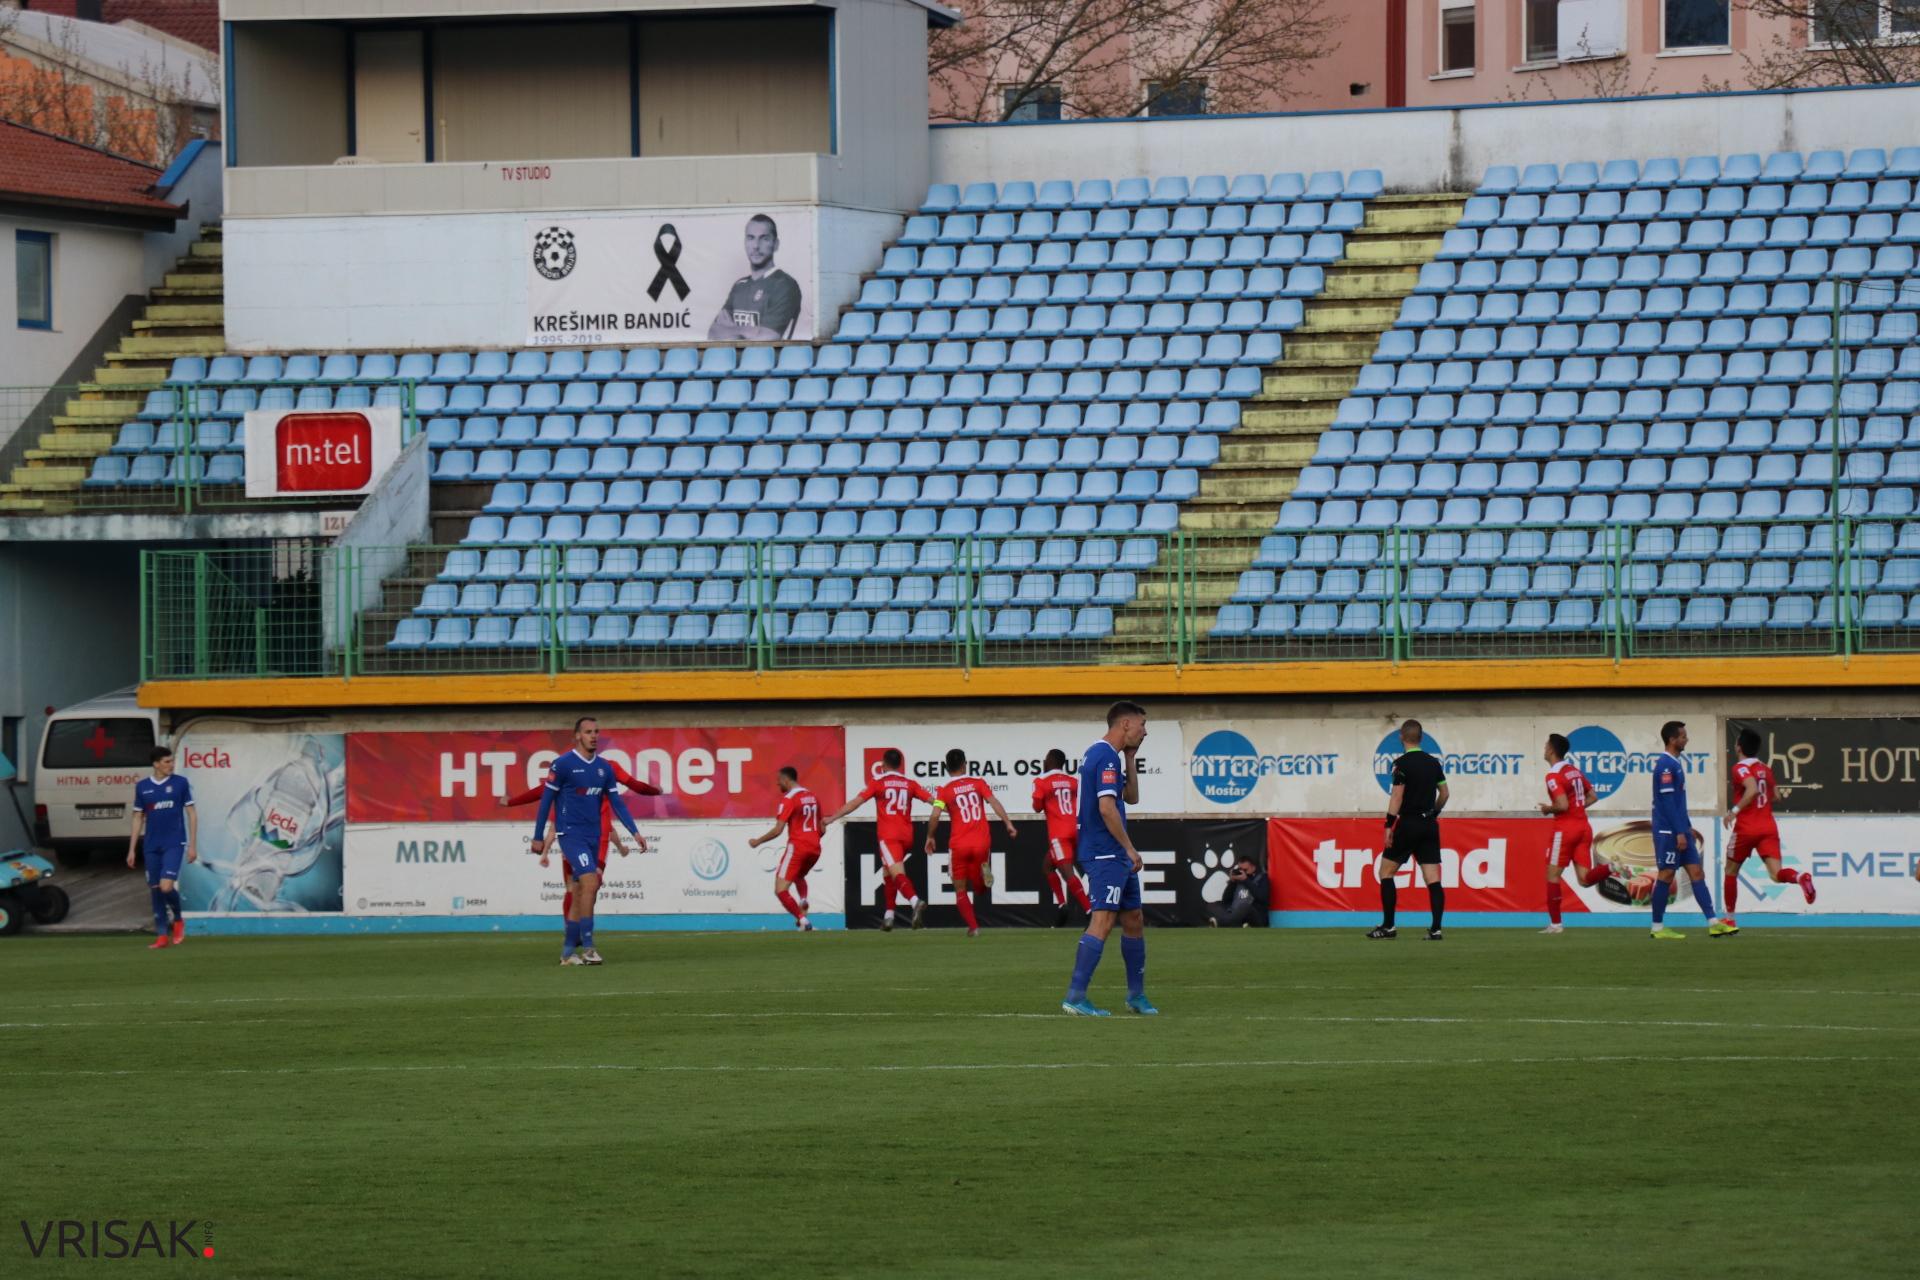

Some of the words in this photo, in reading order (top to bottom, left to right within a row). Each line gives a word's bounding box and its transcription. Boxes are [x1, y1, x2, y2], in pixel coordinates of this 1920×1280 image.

[502, 167, 512, 181] TV
[516, 166, 551, 180] STUDIO
[534, 311, 618, 332] KREŠIMIR
[624, 308, 691, 329] BANDIĆ
[286, 434, 361, 465] m:tel
[183, 747, 231, 768] leda
[914, 760, 1008, 777] CENRAL
[1841, 747, 1920, 783] HOT
[57, 776, 90, 785] HITNA
[1205, 784, 1247, 796] Mostar
[885, 788, 908, 815] 24
[955, 791, 982, 823] 88
[1055, 788, 1073, 815] 18
[267, 808, 297, 835] leda
[803, 804, 817, 832] 21
[395, 840, 467, 863] MRM
[578, 853, 589, 867] 19
[1665, 852, 1676, 864] 22
[860, 850, 1176, 906] KELE
[369, 899, 426, 908] www.mrm.ba
[682, 887, 737, 898] Volkswagen
[1106, 886, 1121, 904] 20
